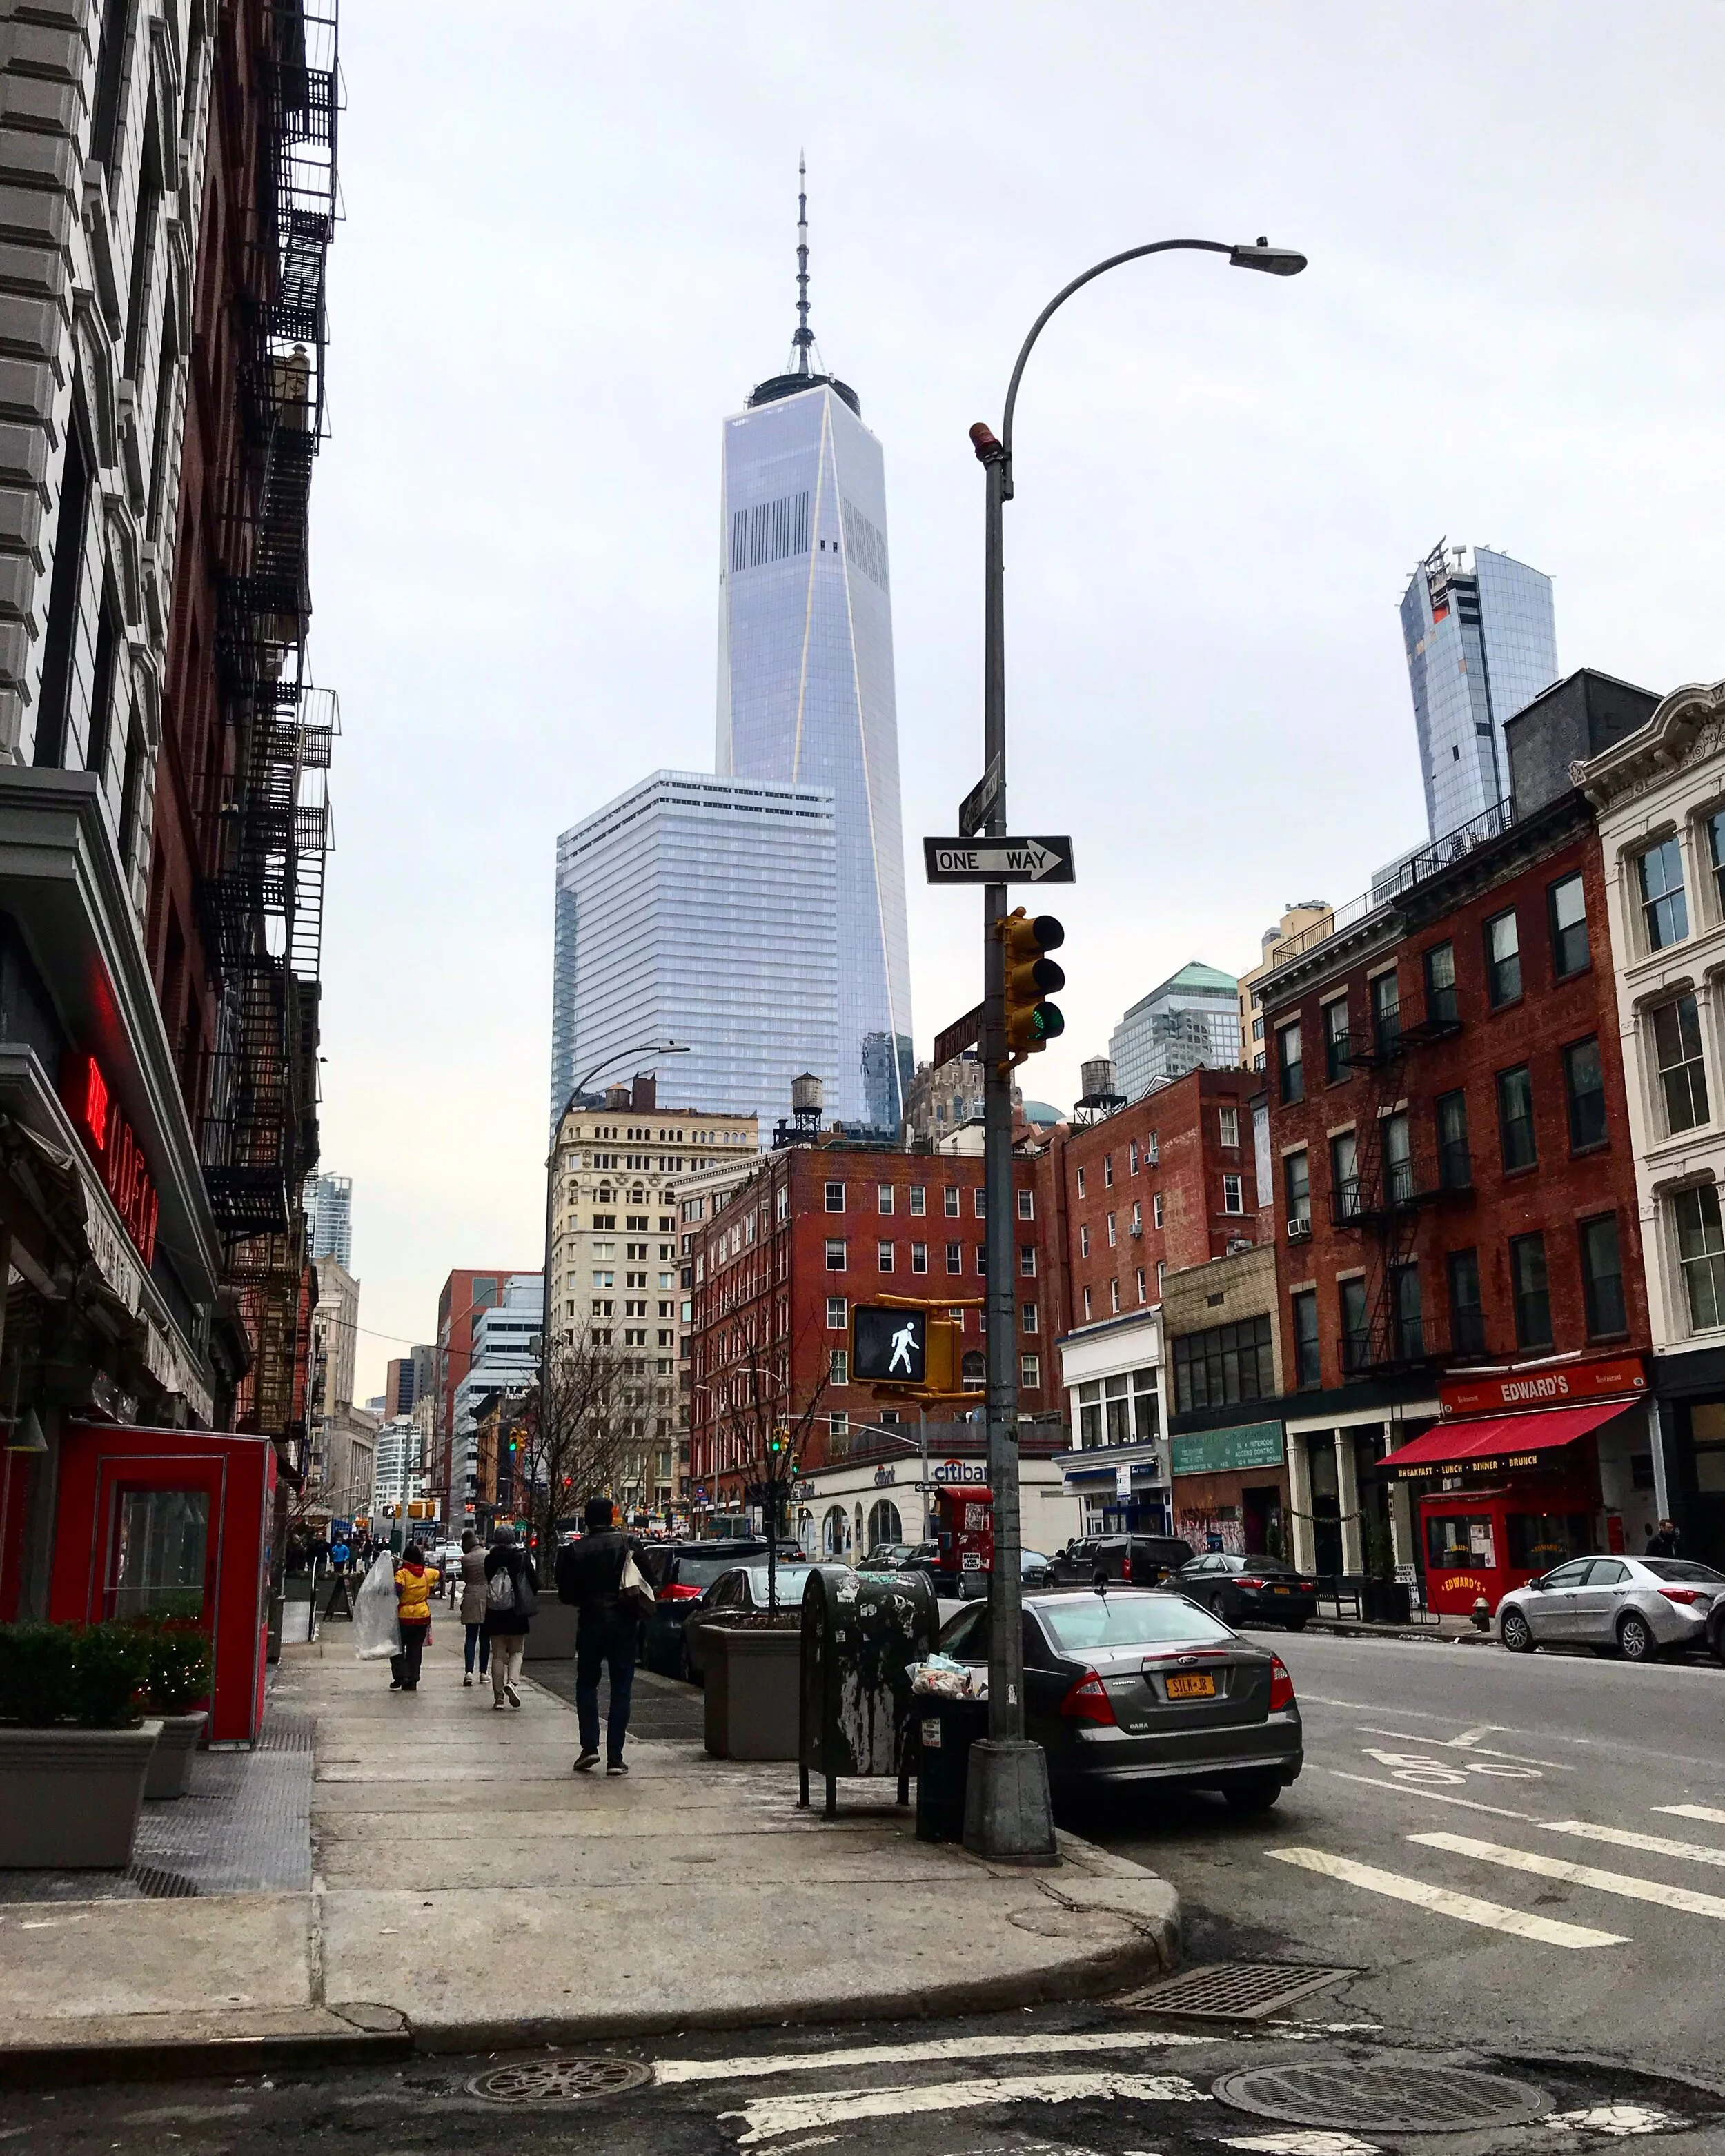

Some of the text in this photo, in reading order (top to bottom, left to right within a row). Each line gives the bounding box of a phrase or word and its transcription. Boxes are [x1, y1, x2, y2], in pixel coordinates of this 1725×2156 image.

[965, 772, 998, 828] ONE WAY
[940, 851, 1047, 869] ONE WAY
[945, 1009, 983, 1057] BROADWA
[109, 1102, 159, 1271] ODEON
[1501, 1375, 1569, 1402] EDWARD'S
[1235, 1450, 1252, 1458] ACCESS
[934, 1461, 987, 1481] citiba
[1398, 1455, 1537, 1477] BREAKFAST LUNCH DINNER BRUNCH
[1445, 1576, 1481, 1592] EDWARD'S
